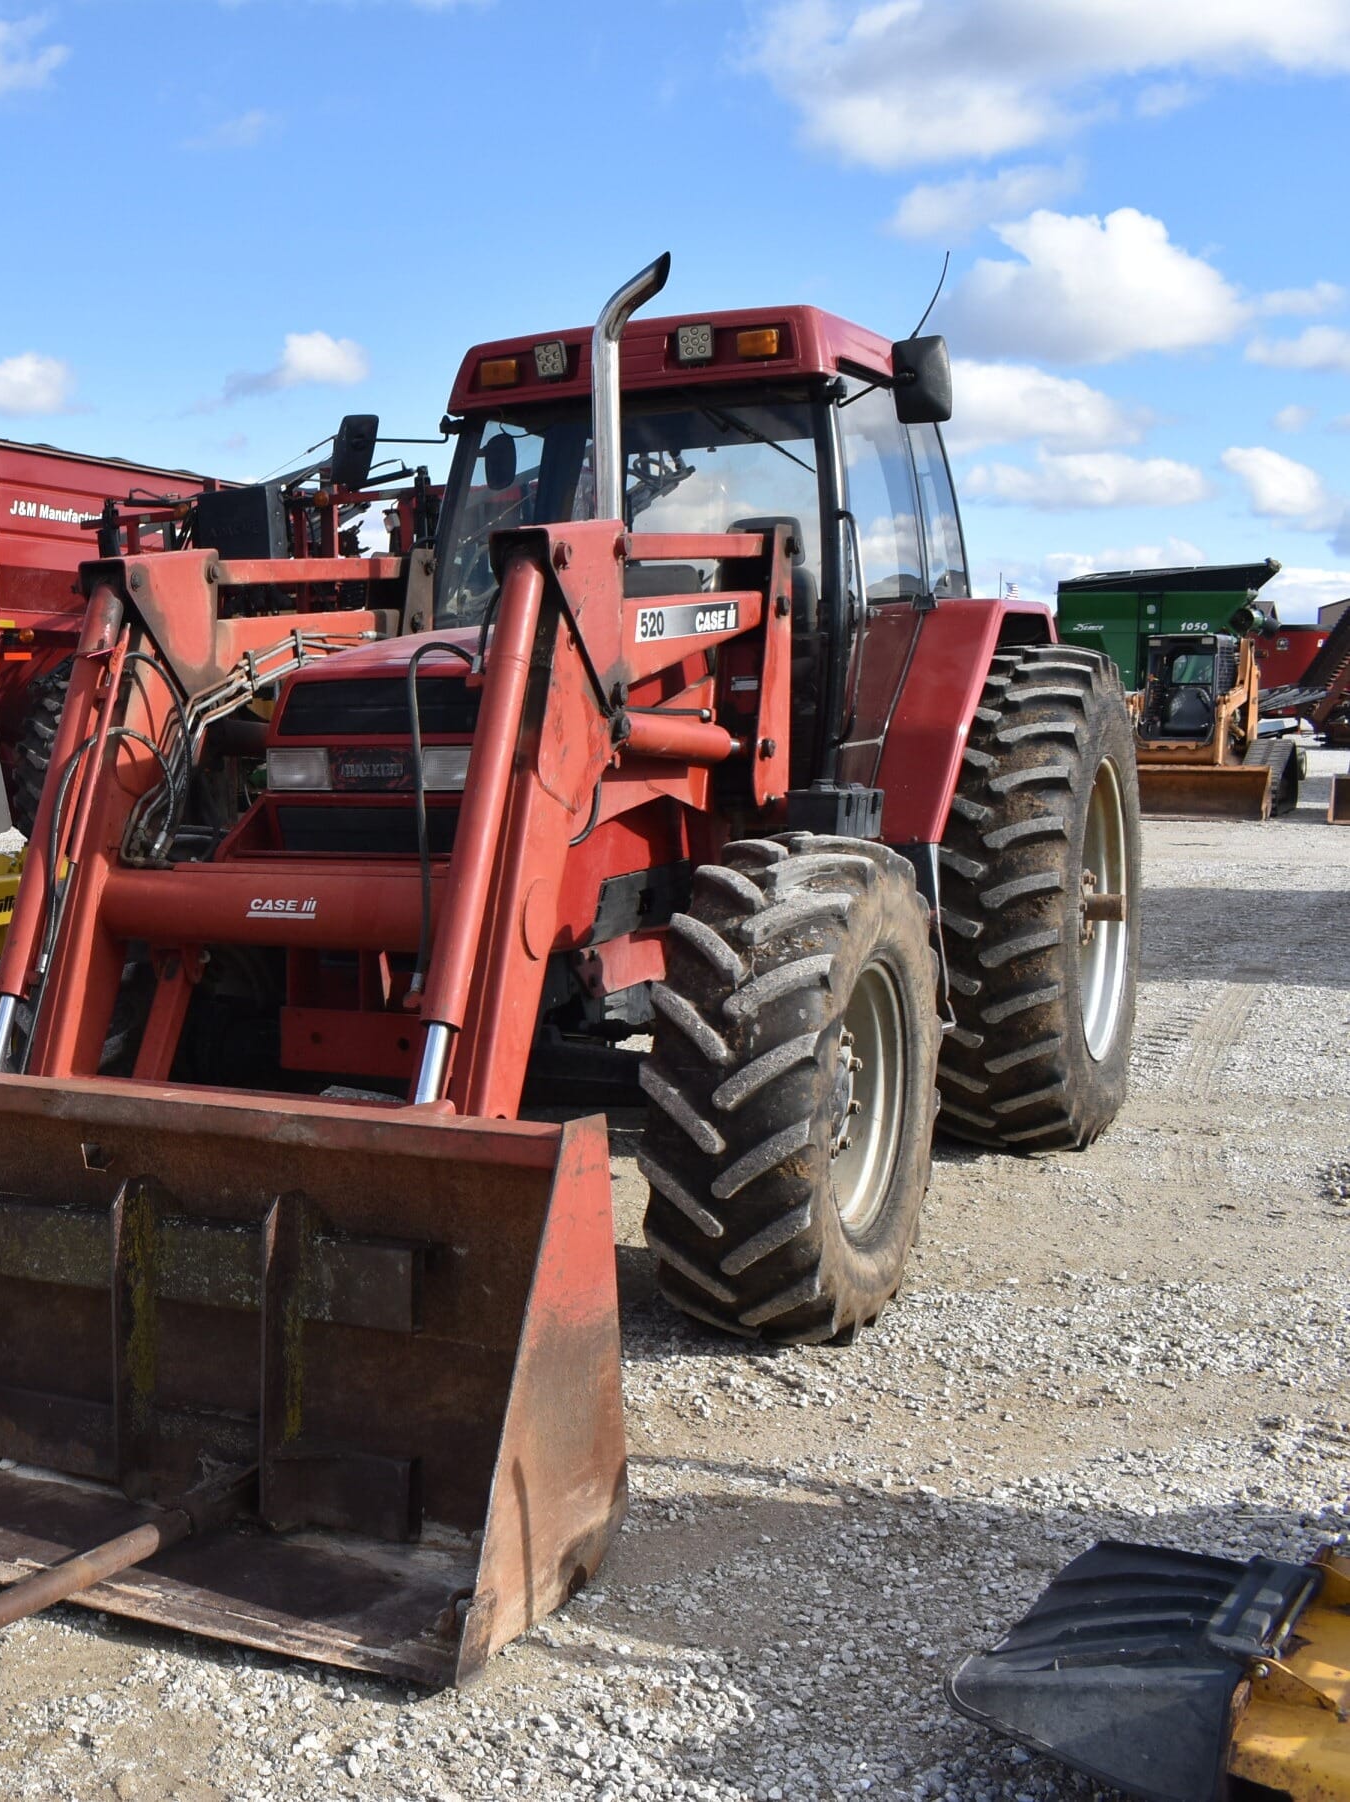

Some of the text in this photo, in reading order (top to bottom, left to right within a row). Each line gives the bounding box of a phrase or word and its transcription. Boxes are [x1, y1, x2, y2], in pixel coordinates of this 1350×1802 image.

[10, 500, 36, 517] J&M
[640, 610, 665, 638] 520
[695, 610, 725, 632] CASE
[1072, 622, 1104, 631] Demco
[1180, 622, 1209, 631] 1050
[250, 898, 298, 911] CASE
